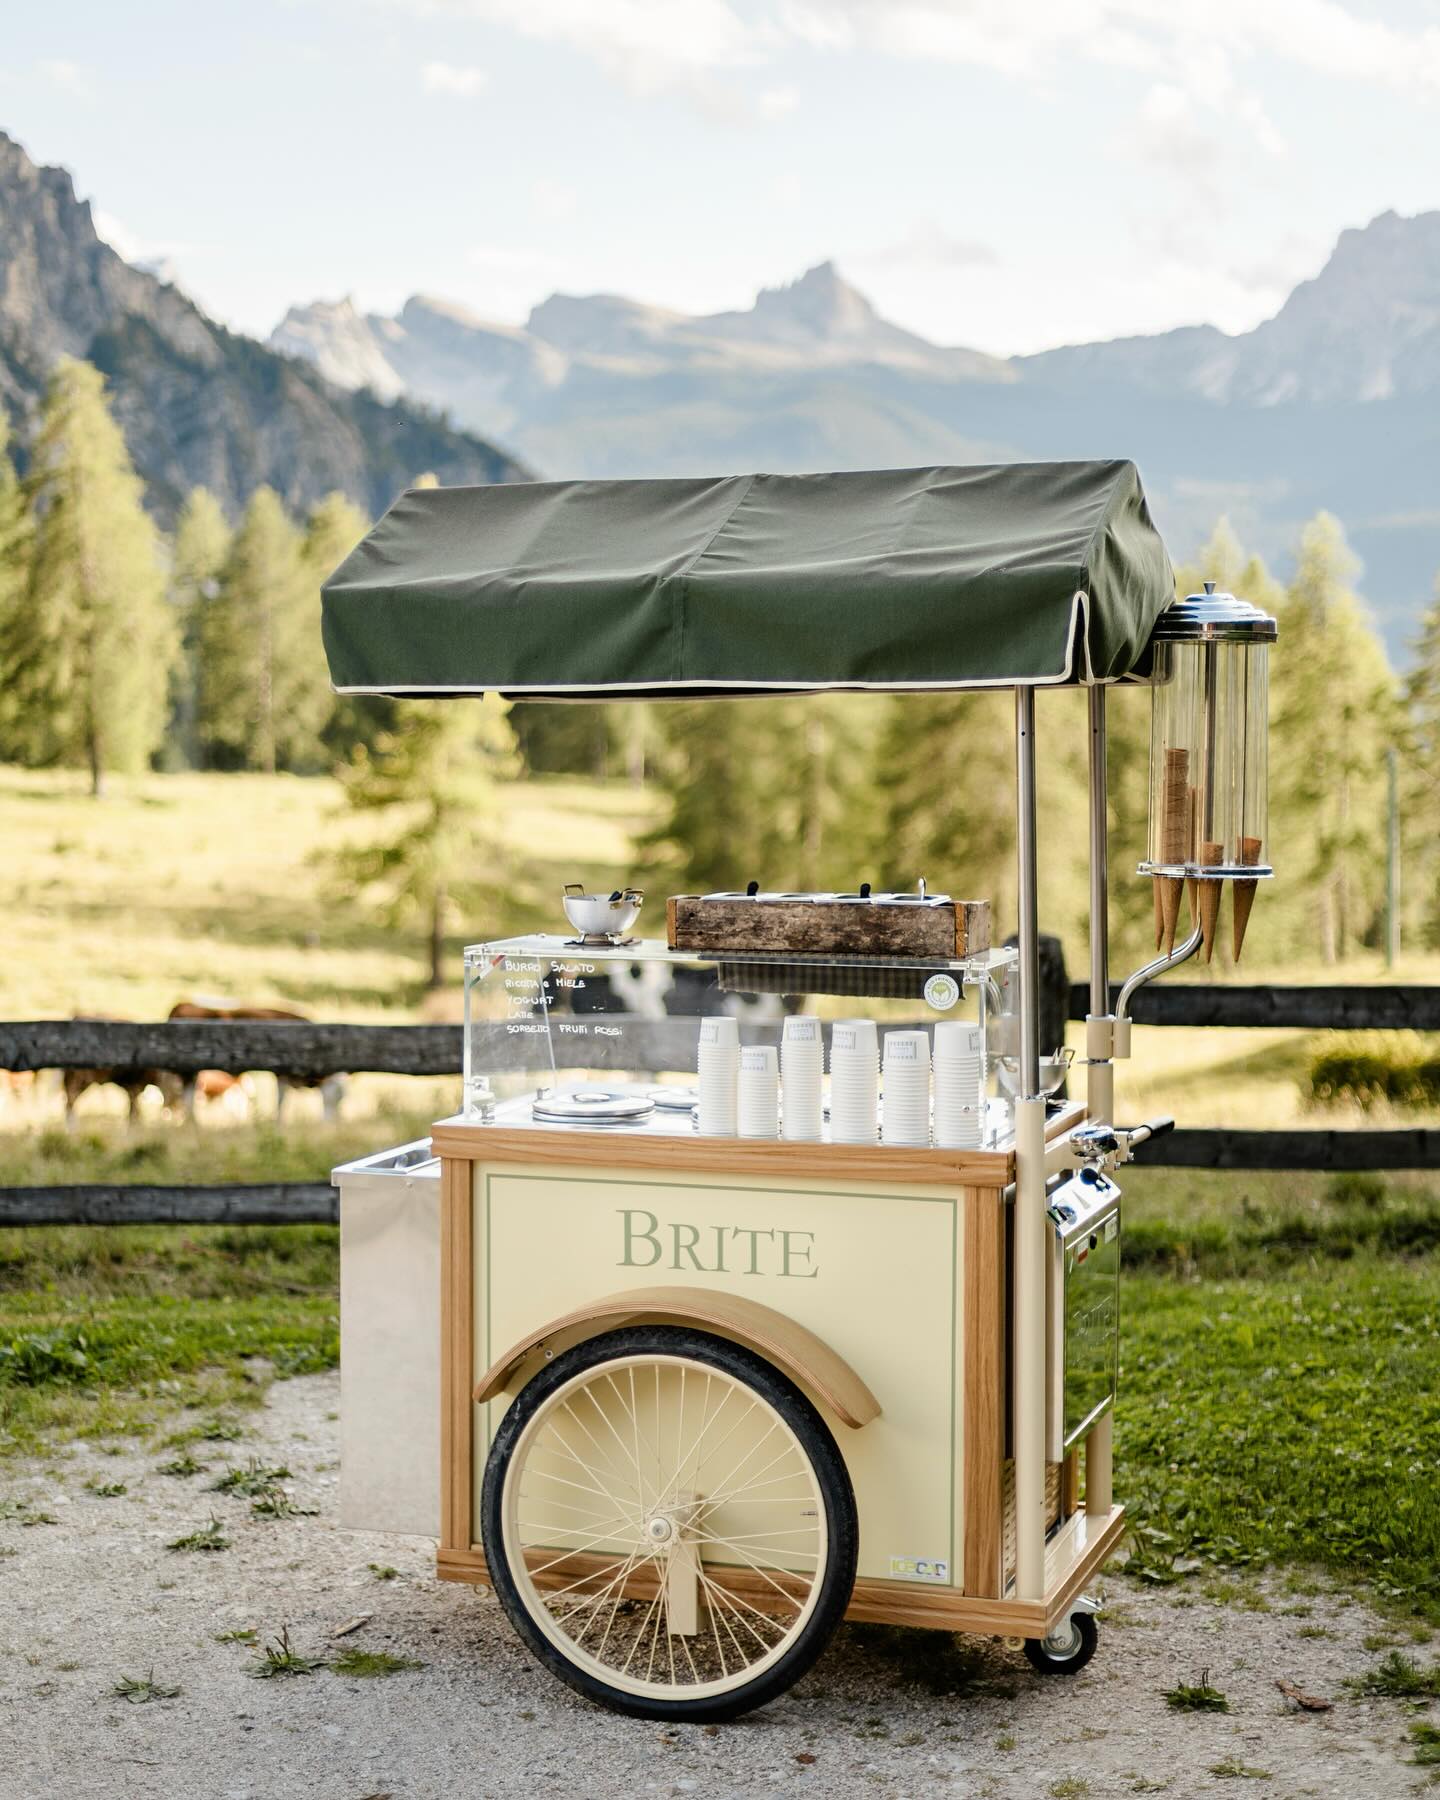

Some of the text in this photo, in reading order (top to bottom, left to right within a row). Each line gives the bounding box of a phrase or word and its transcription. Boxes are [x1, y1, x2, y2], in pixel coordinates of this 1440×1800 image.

[504, 960, 595, 973] BURRO SALATO
[508, 995, 554, 1005] YOGURT
[507, 1011, 534, 1019] LATTE
[506, 1024, 550, 1034] SORBETTO
